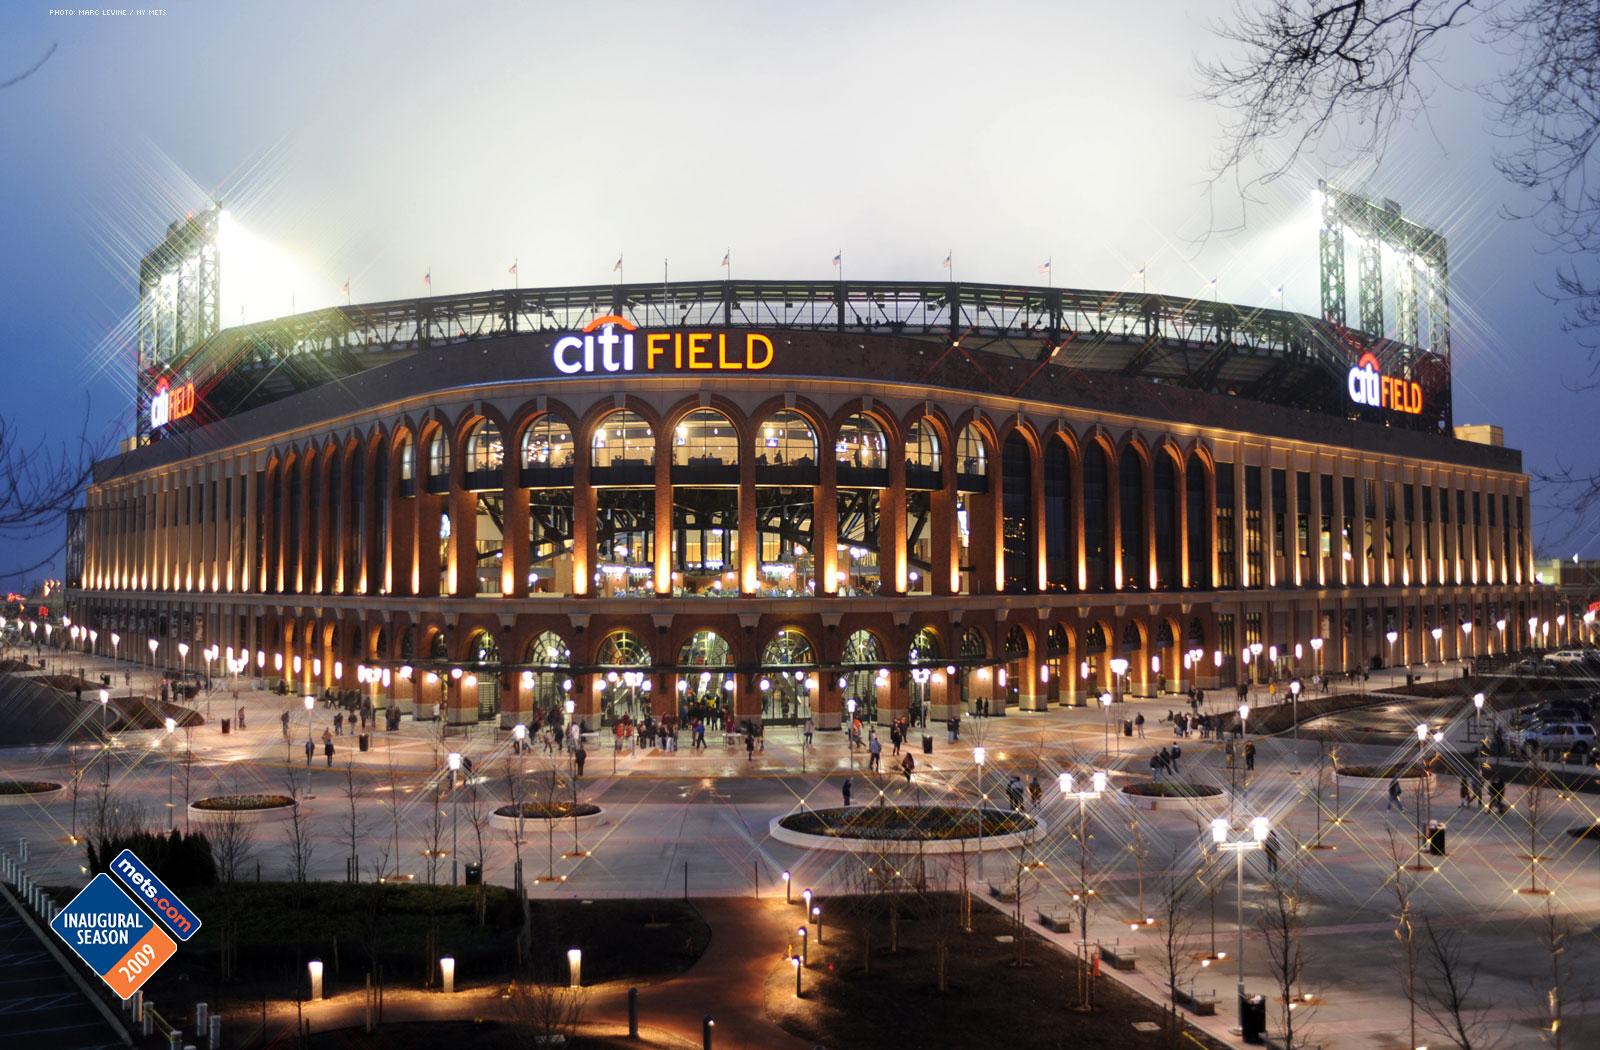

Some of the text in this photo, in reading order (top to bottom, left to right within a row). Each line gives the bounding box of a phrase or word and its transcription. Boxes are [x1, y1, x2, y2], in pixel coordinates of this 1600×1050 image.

[552, 323, 775, 374] citi FIELD
[169, 383, 195, 421] FIELD
[1381, 375, 1423, 415] FIELD
